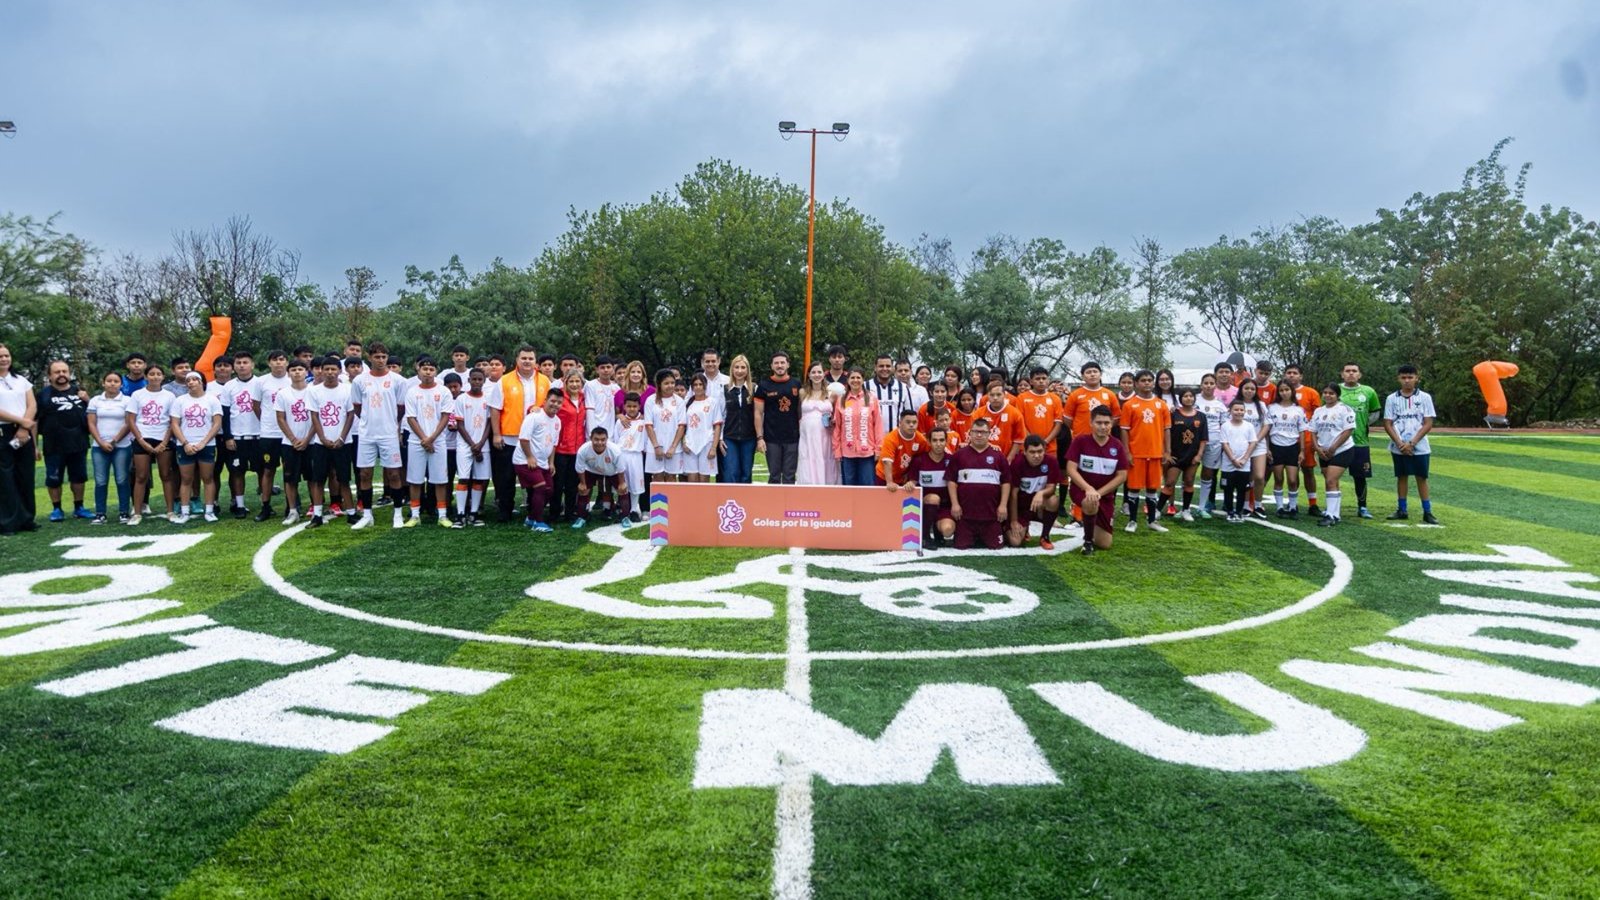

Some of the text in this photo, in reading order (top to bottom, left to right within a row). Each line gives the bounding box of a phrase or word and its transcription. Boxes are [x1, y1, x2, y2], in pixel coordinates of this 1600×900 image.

[753, 518, 780, 527] Goles
[781, 519, 798, 529] por
[799, 518, 809, 527] la
